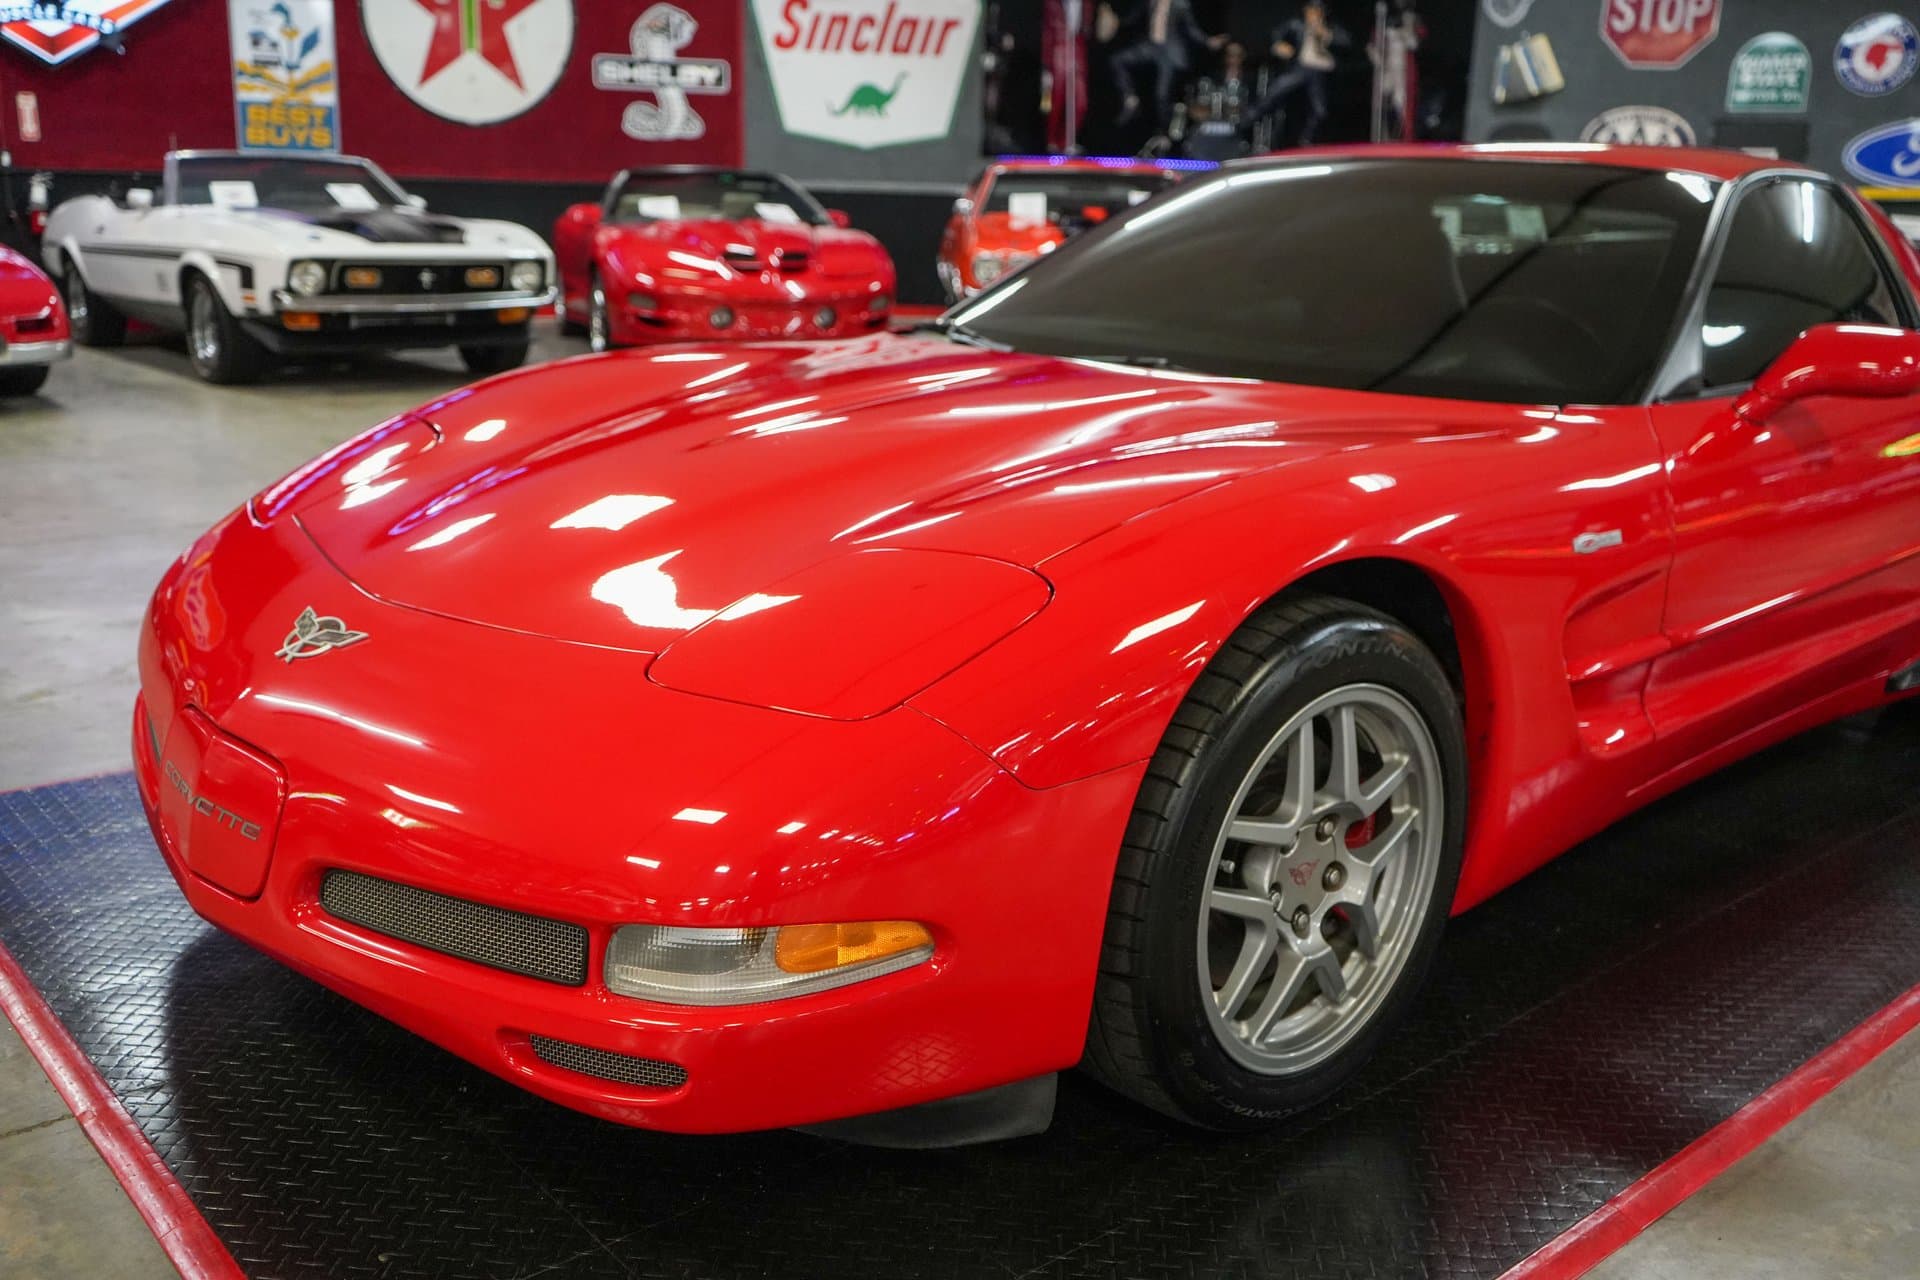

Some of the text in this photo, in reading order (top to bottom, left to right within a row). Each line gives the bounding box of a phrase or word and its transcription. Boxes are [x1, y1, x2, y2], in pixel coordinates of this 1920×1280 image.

[0, 3, 58, 22] USCLE
[1610, 0, 1713, 33] STOP
[774, 0, 961, 55] Sinclair
[598, 60, 722, 87] SHELBY
[246, 103, 327, 126] BEST
[245, 125, 332, 147] BUYS
[165, 759, 262, 841] CORVETTE
